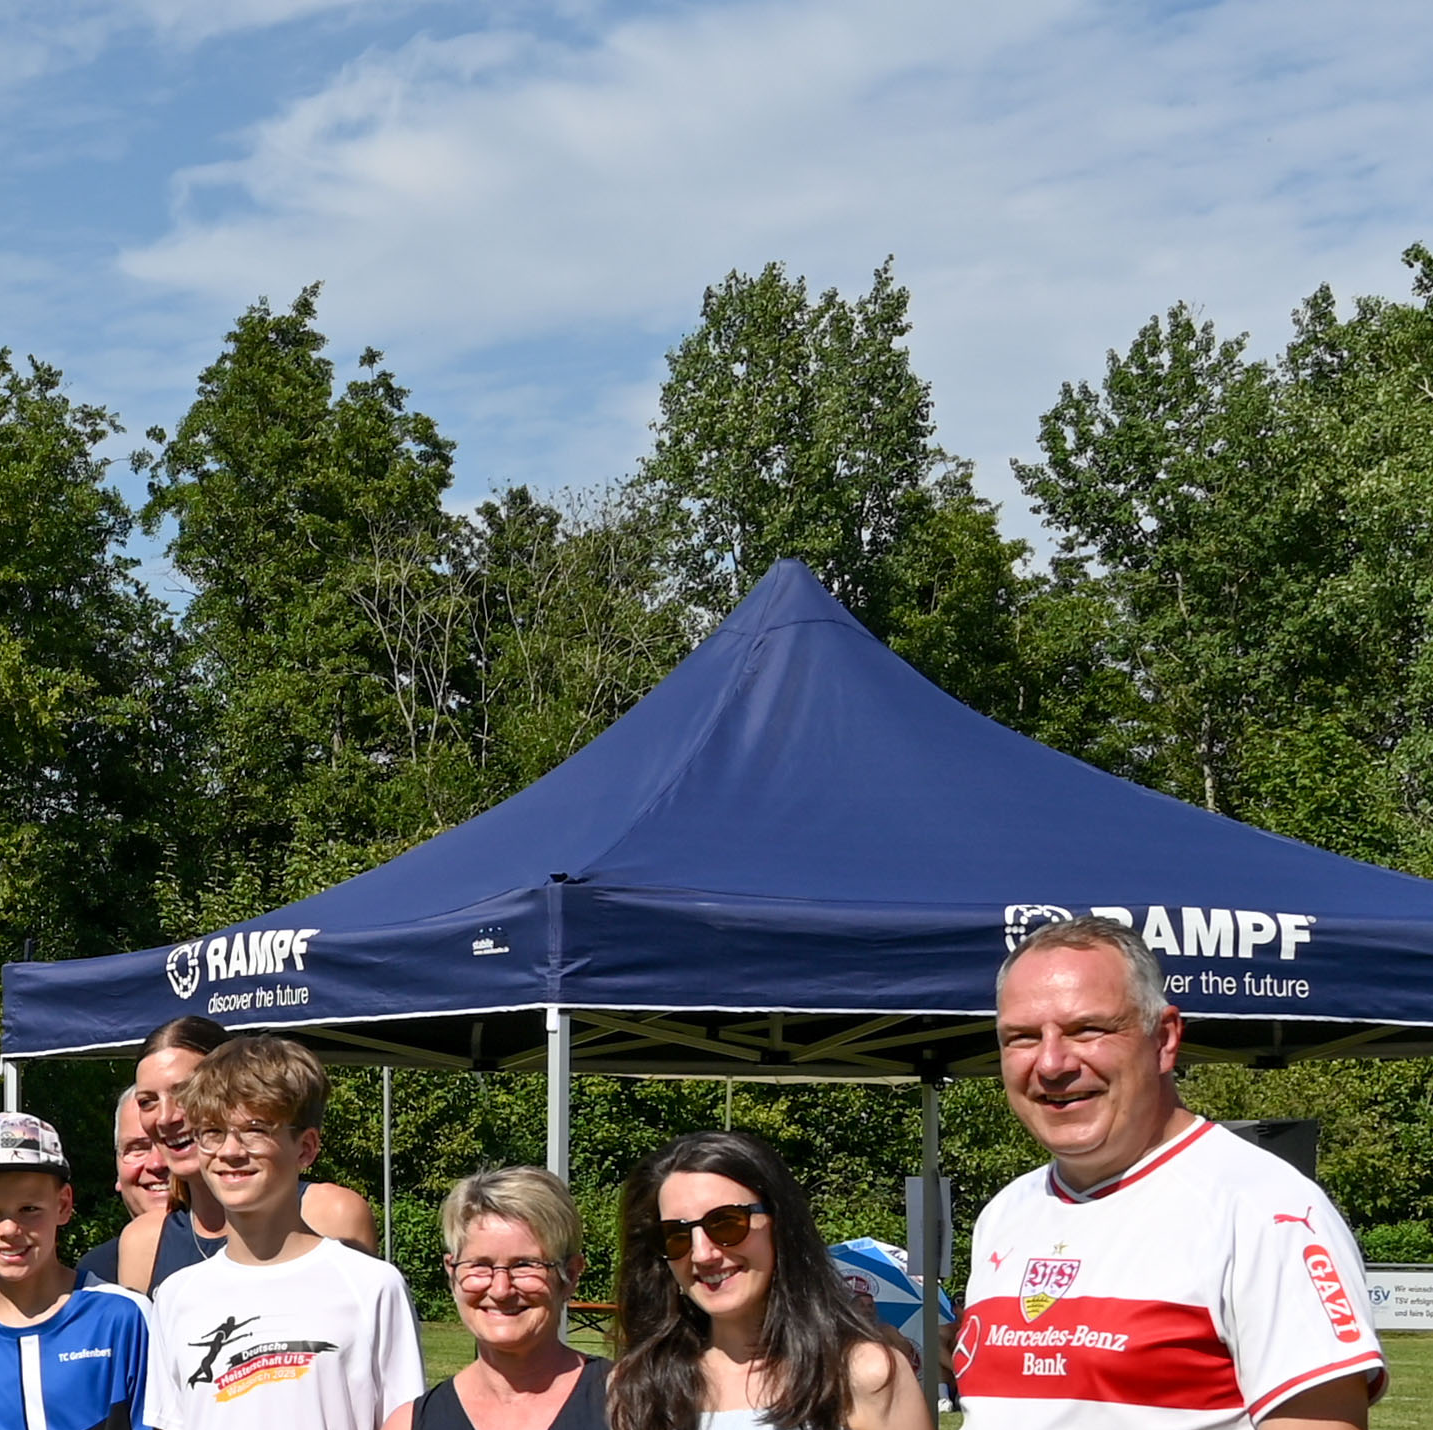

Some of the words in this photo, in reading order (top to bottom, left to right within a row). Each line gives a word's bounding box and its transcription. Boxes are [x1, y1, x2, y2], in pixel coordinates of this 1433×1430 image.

[206, 929, 319, 981] RAMPF
[1200, 970, 1237, 995] the
[1243, 971, 1309, 998] future
[207, 992, 253, 1014] discover
[255, 986, 274, 1008] the
[276, 984, 309, 1006] future
[1306, 1252, 1359, 1340] GAZI
[1367, 1289, 1391, 1302] TSV
[242, 1342, 288, 1360] Deutsche
[985, 1324, 1129, 1352] Mercedes-Benz
[58, 1353, 69, 1362] TC
[220, 1355, 282, 1386] Meisterschaft
[1022, 1352, 1067, 1376] Bank
